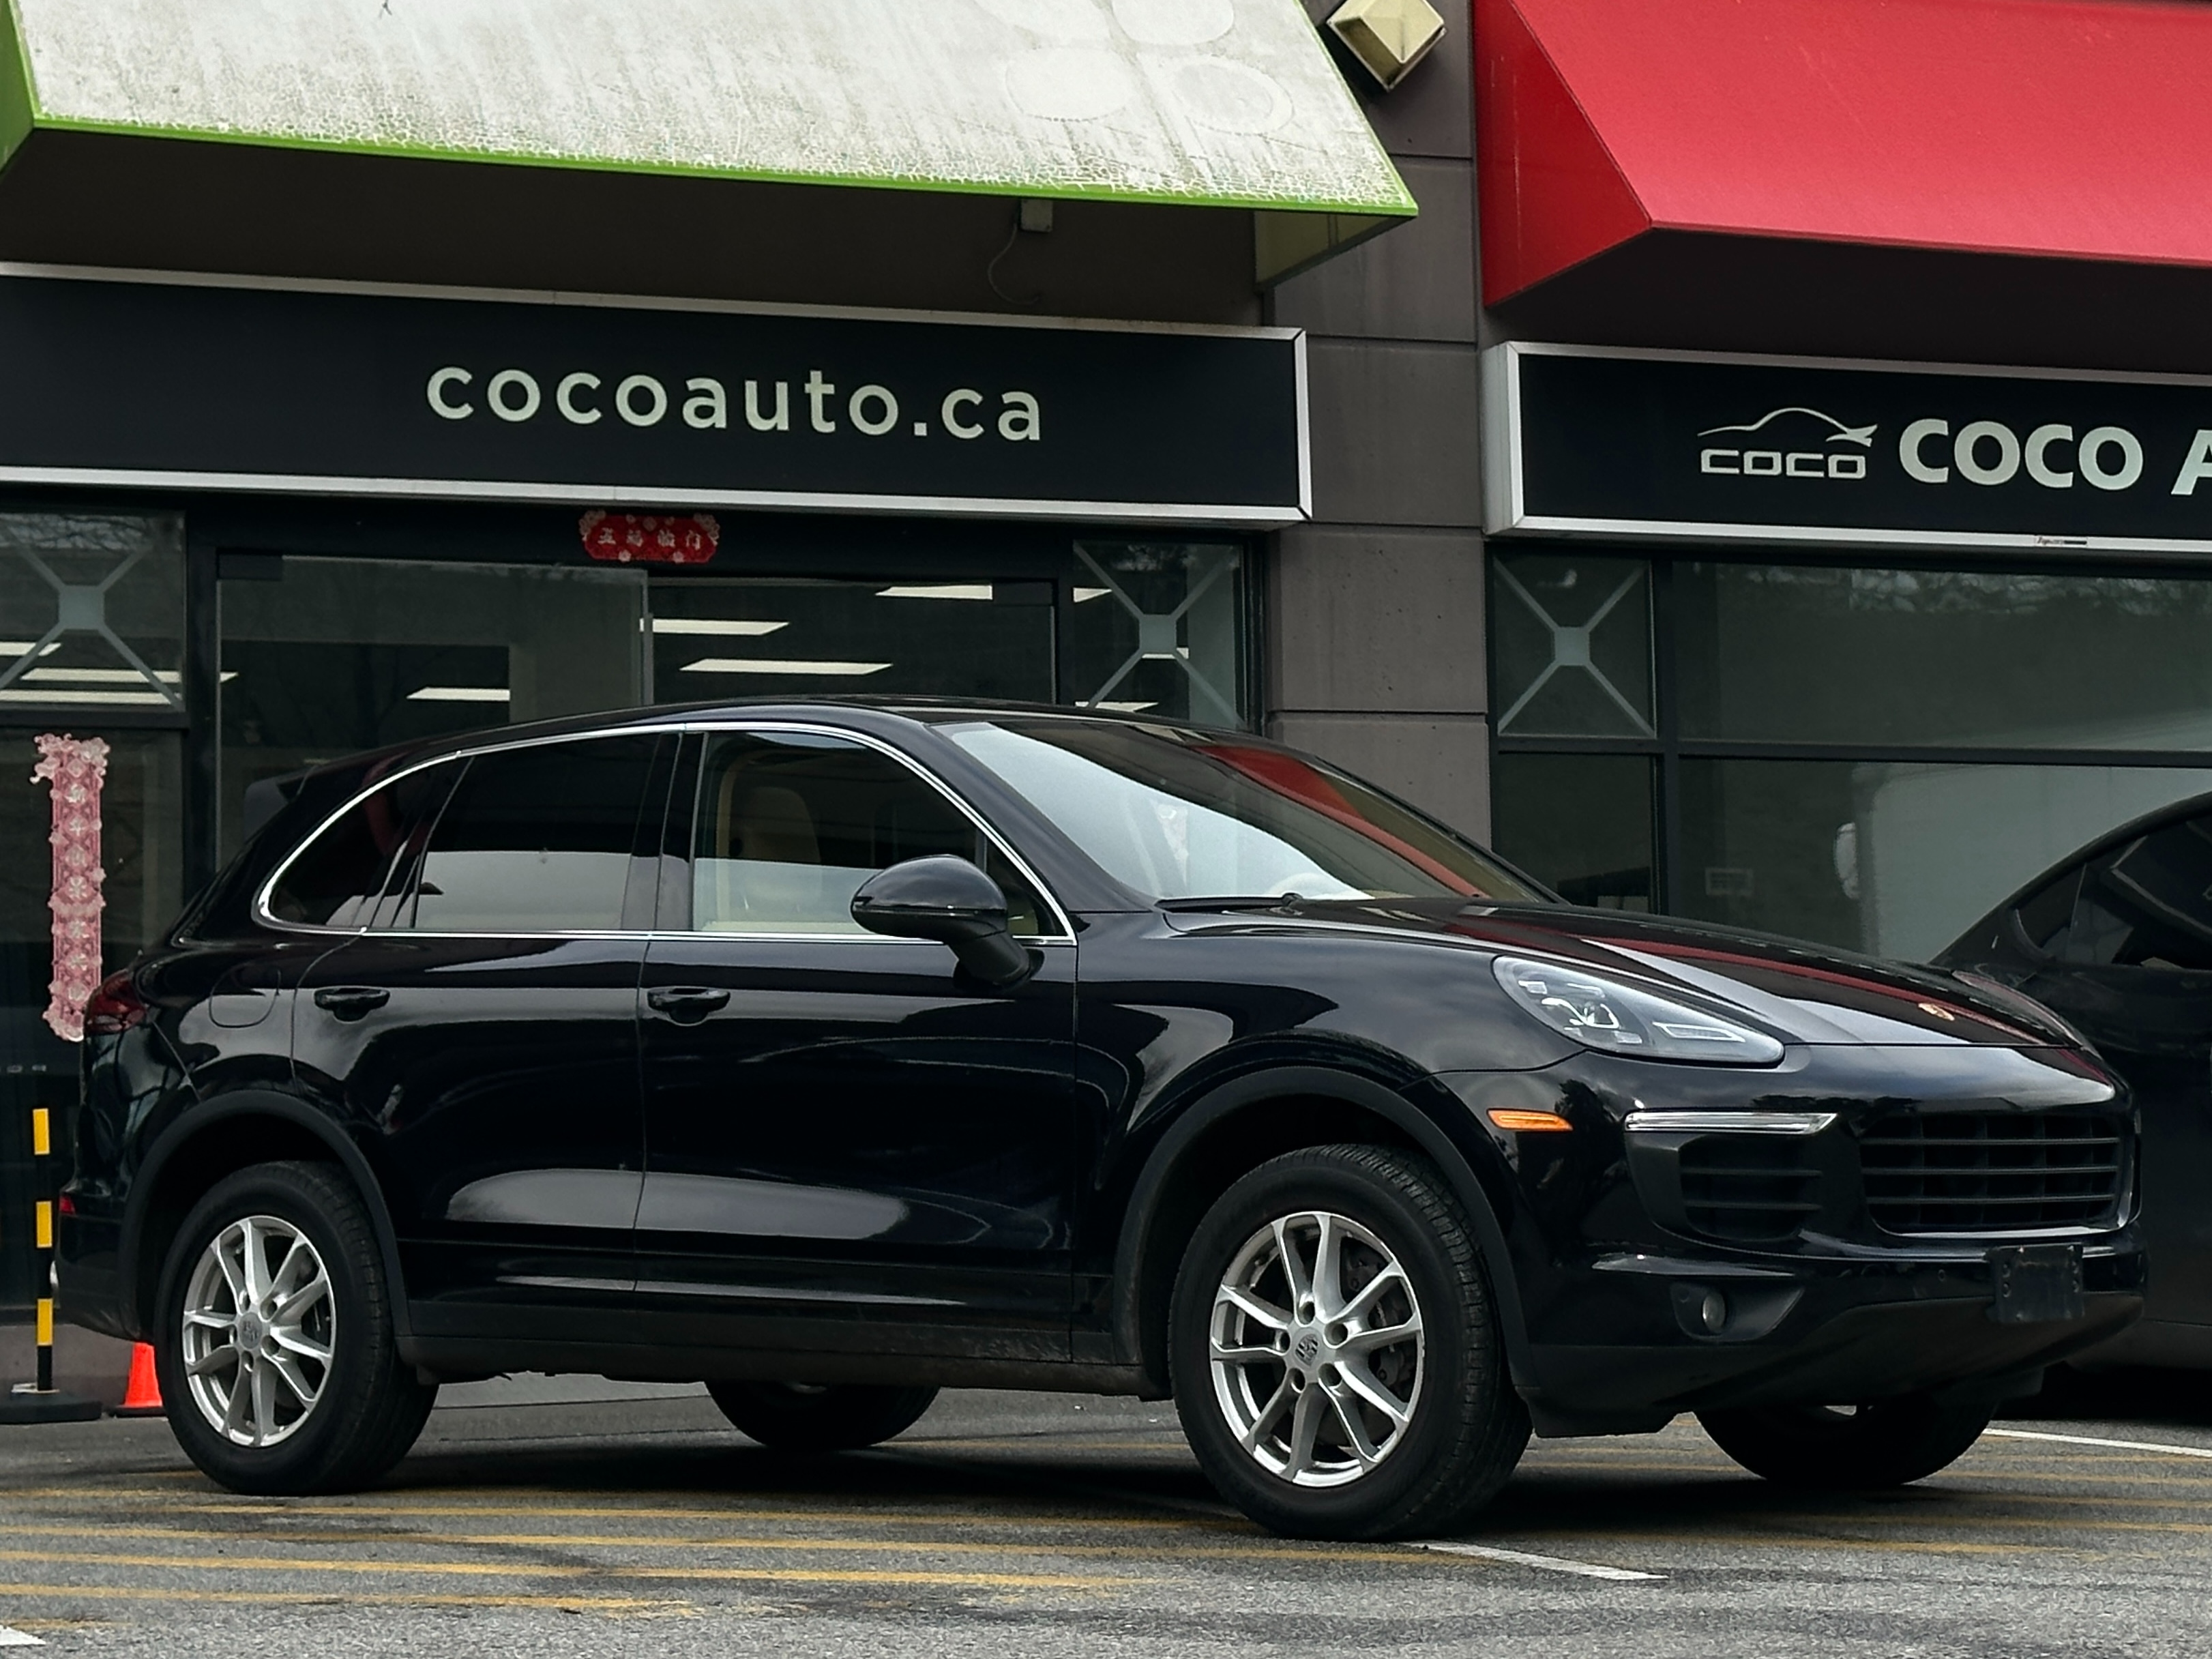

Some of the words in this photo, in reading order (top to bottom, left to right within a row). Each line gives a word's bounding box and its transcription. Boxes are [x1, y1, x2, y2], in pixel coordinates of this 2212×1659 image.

[427, 367, 1040, 441] cocoauto.ca
[1700, 449, 1866, 479] COCO
[1899, 418, 2144, 490] COCO
